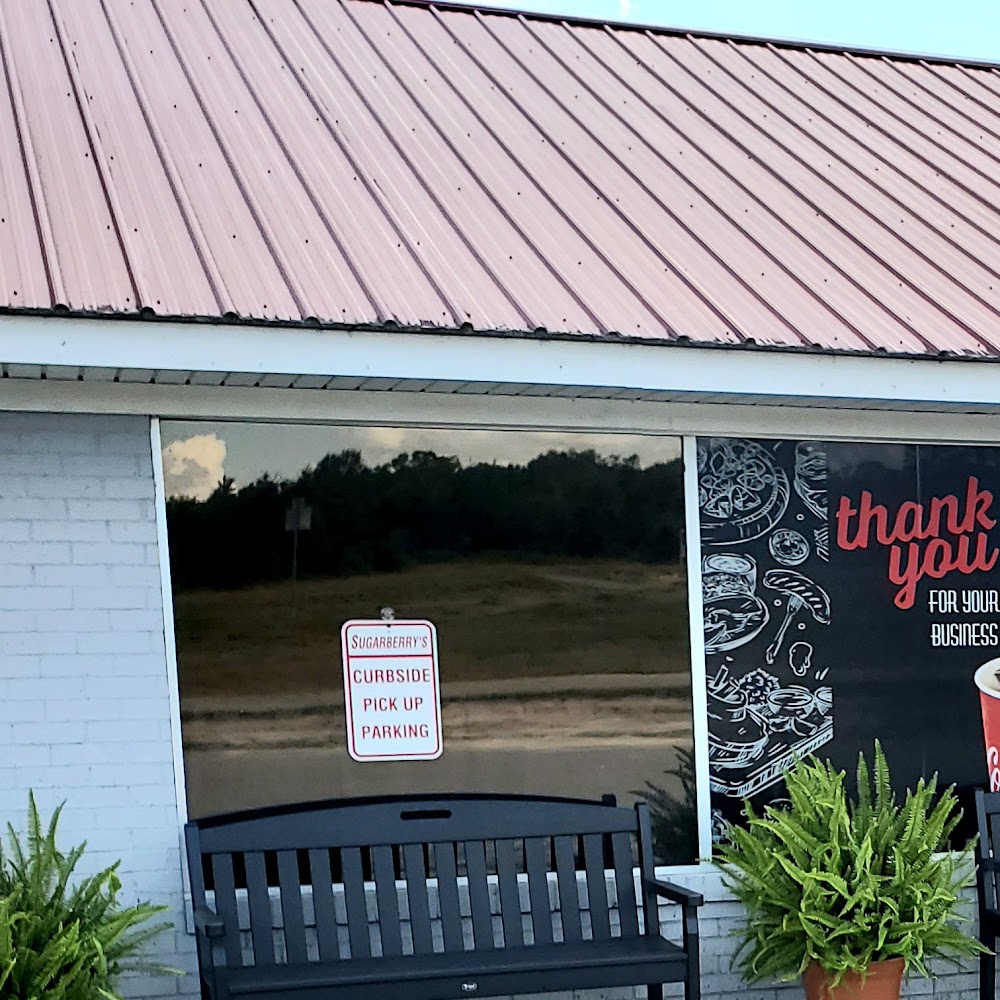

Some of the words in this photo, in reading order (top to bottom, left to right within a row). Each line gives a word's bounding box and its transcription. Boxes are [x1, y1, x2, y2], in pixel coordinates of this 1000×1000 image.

[836, 476, 996, 551] thank
[888, 532, 999, 610] you
[928, 590, 959, 613] FOR
[962, 589, 1000, 613] YOUR
[352, 635, 428, 649] SUGARBERRY'S
[930, 623, 999, 647] BUSINESS
[353, 669, 430, 683] CURBSIDE
[363, 697, 398, 711] PICK
[403, 697, 423, 711] UP
[362, 724, 429, 739] PARKING
